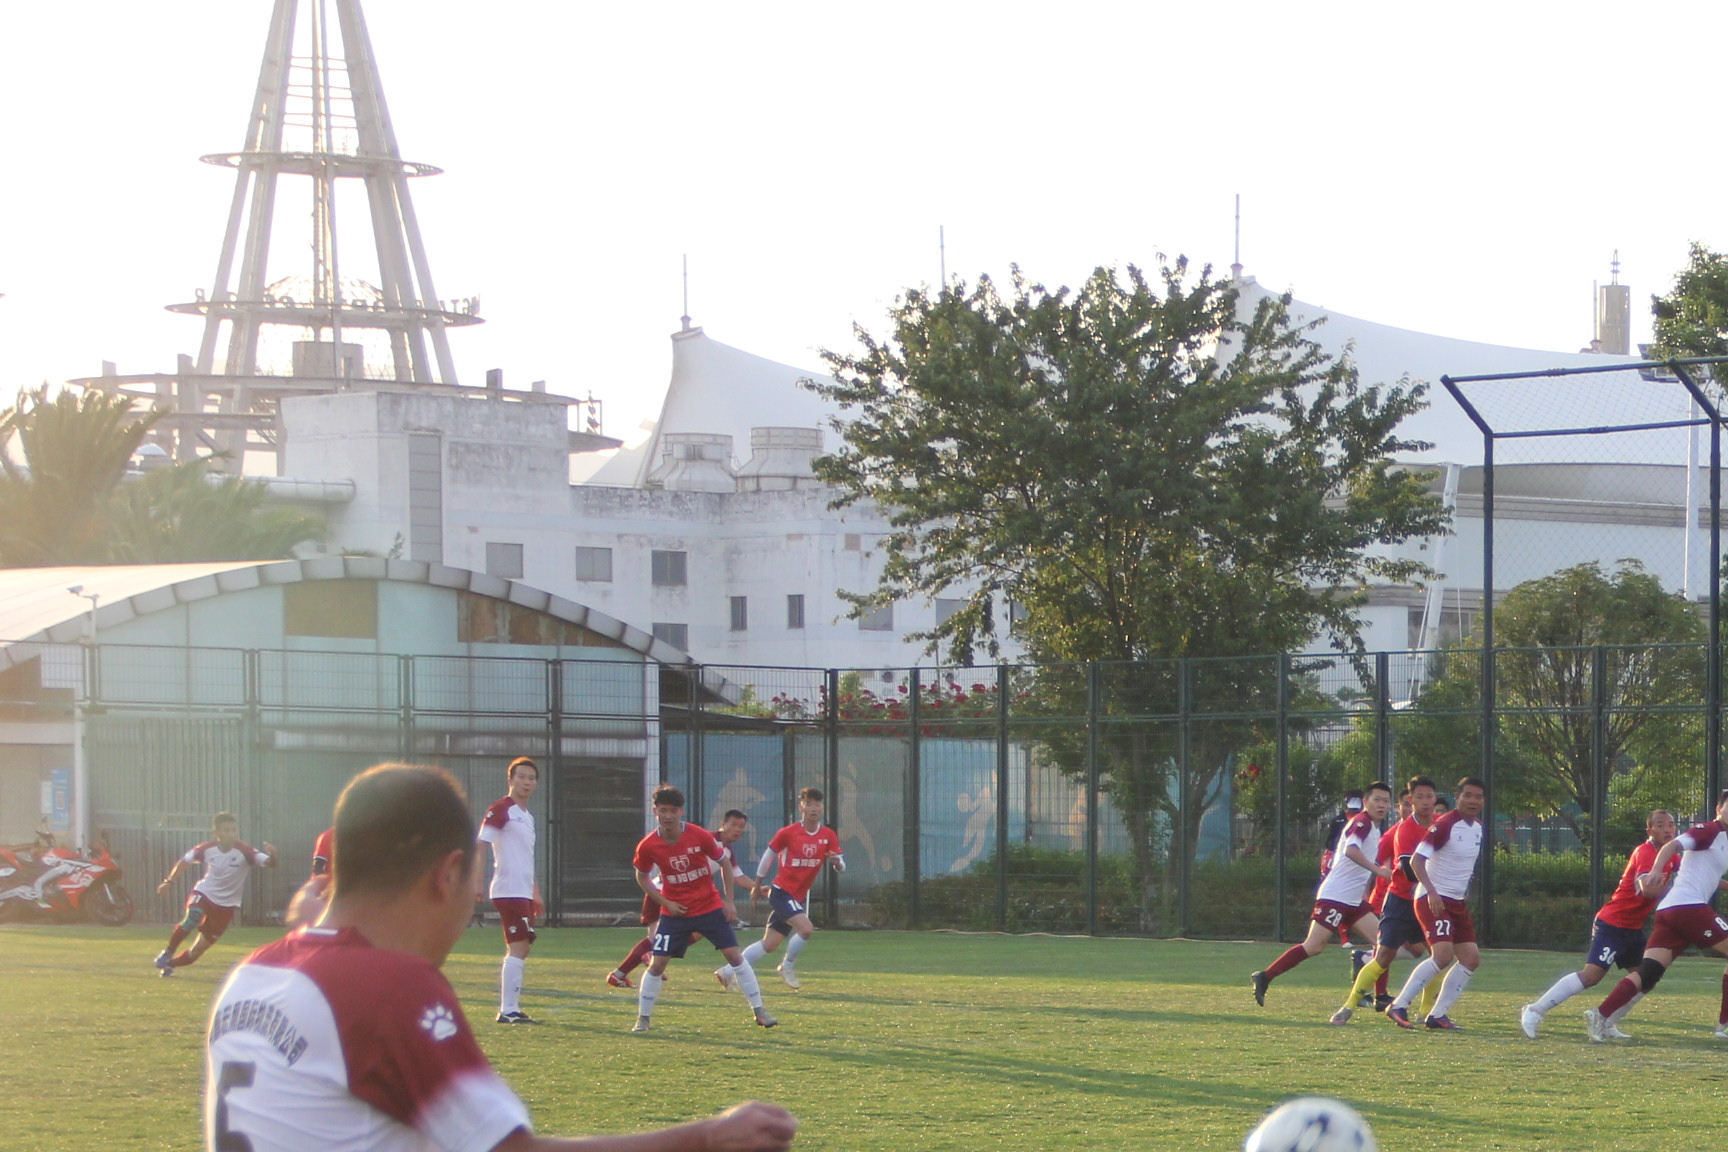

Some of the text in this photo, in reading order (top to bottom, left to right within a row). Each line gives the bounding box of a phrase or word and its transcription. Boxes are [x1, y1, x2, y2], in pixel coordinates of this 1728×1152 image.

[1325, 909, 1342, 927] 28
[1435, 920, 1450, 936] 27
[654, 934, 670, 951] 21
[1599, 947, 1616, 965] 36
